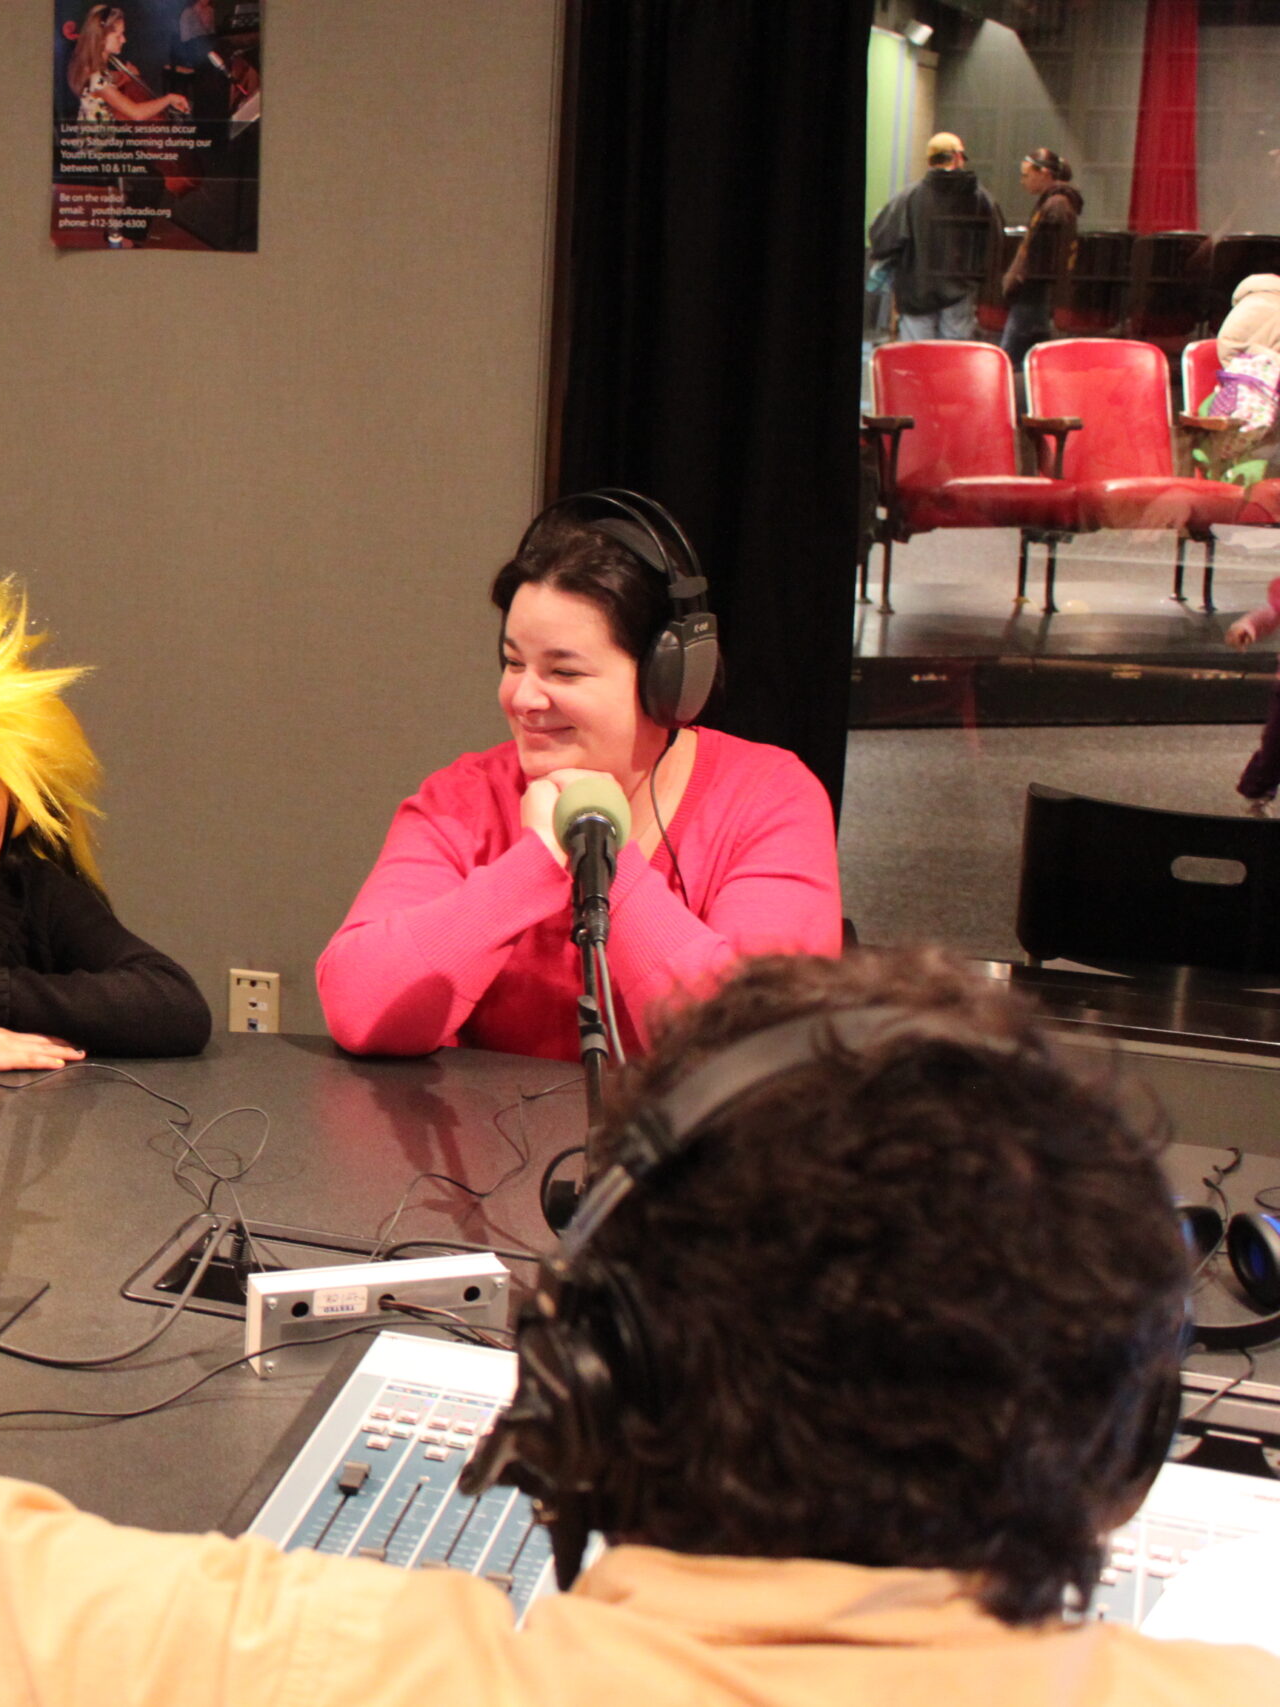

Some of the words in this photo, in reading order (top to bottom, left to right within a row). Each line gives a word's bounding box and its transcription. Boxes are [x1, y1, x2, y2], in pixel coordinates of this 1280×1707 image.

[60, 124, 79, 133] Live
[80, 124, 106, 135] youth
[106, 124, 132, 133] music
[134, 124, 169, 134] sessions
[171, 125, 197, 134] occur
[60, 138, 84, 148] every
[86, 136, 124, 149] Saturday
[125, 138, 163, 149] morning
[165, 137, 194, 149] during
[196, 139, 212, 147] our
[60, 150, 86, 159] Youth
[87, 150, 133, 160] Expression
[135, 150, 179, 160] Showcase
[60, 163, 99, 172] between
[101, 163, 111, 173] 10
[112, 163, 120, 173] &
[121, 164, 148, 173] 11am.
[60, 193, 71, 202] Be
[72, 194, 84, 202] on
[84, 193, 99, 202] the
